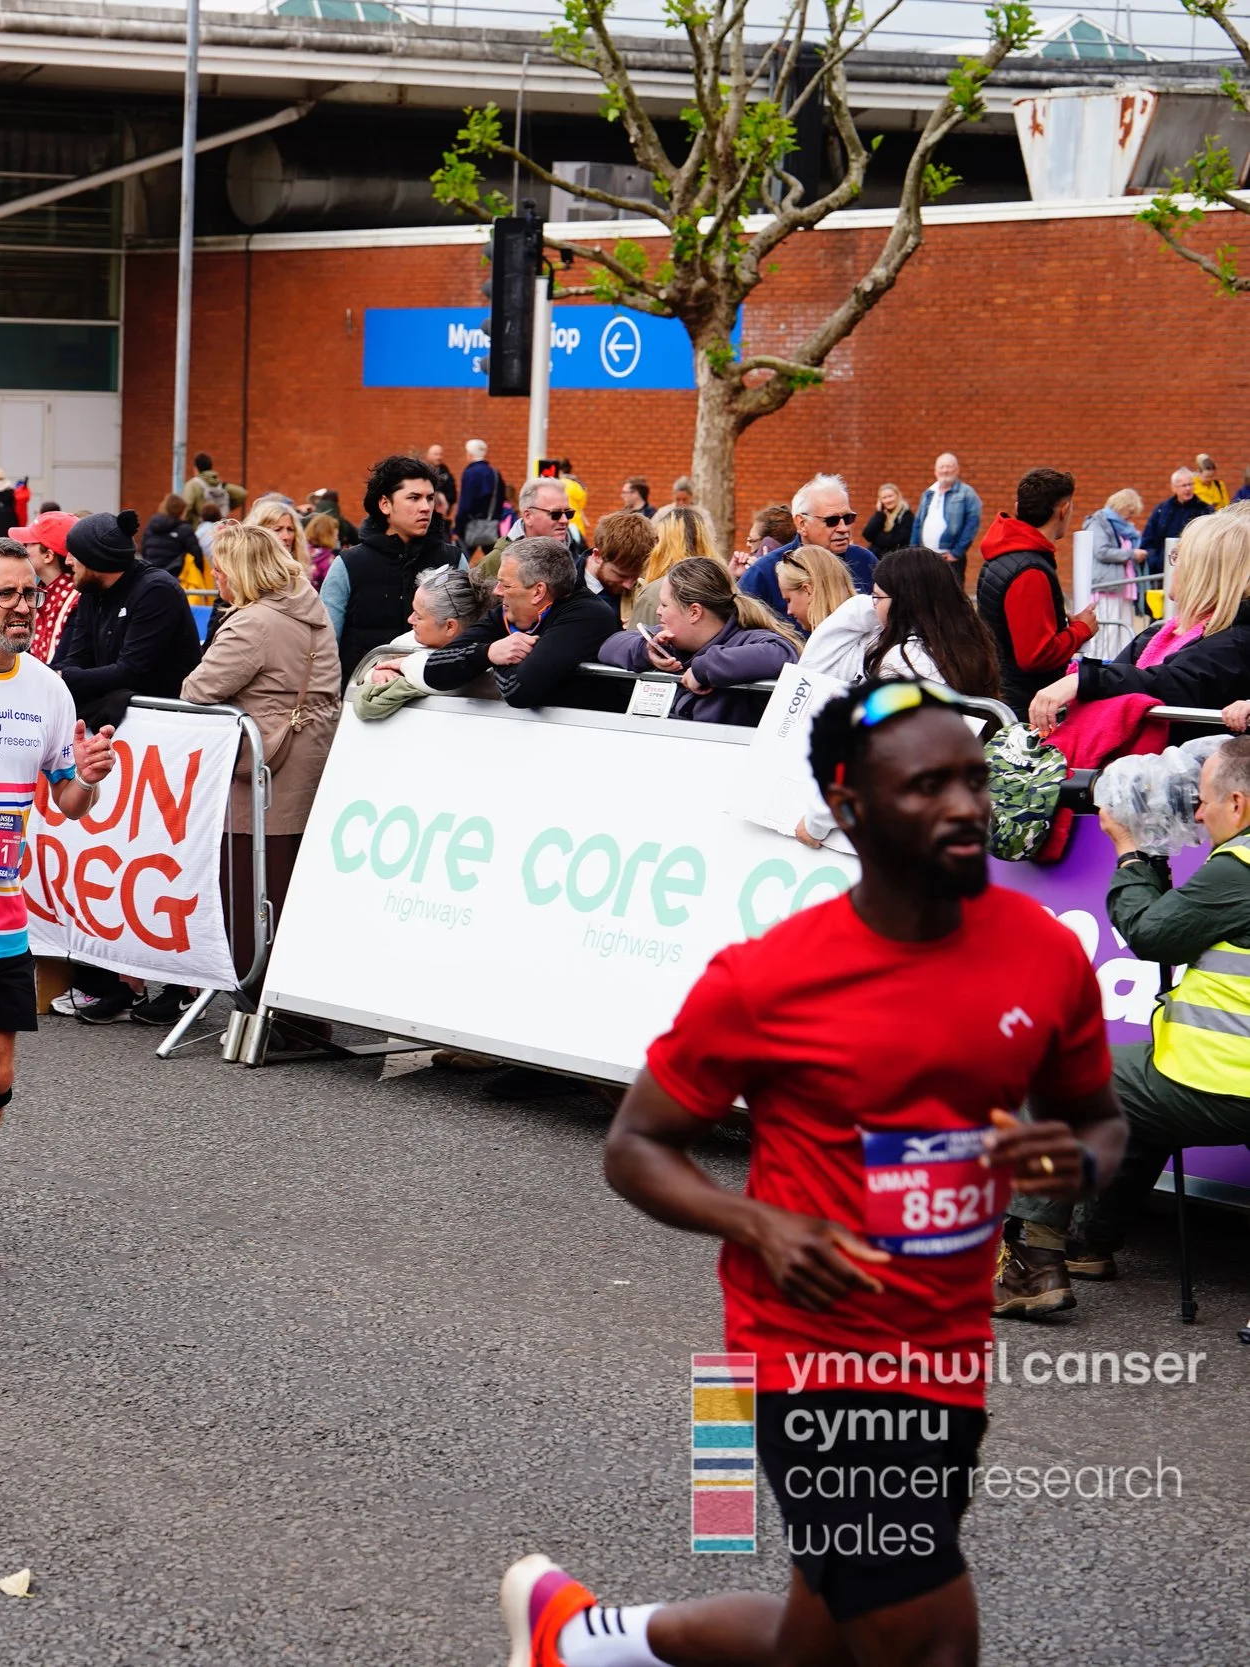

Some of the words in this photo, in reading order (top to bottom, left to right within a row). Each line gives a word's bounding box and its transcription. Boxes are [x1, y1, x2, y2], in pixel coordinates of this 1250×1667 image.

[550, 322, 581, 355] iop
[4, 736, 41, 748] research
[331, 799, 494, 892] core
[522, 827, 707, 927] core
[738, 858, 853, 939] co
[383, 889, 473, 930] highways
[582, 923, 683, 967] highways
[867, 1169, 929, 1193] UMAR
[902, 1179, 995, 1231] 8521
